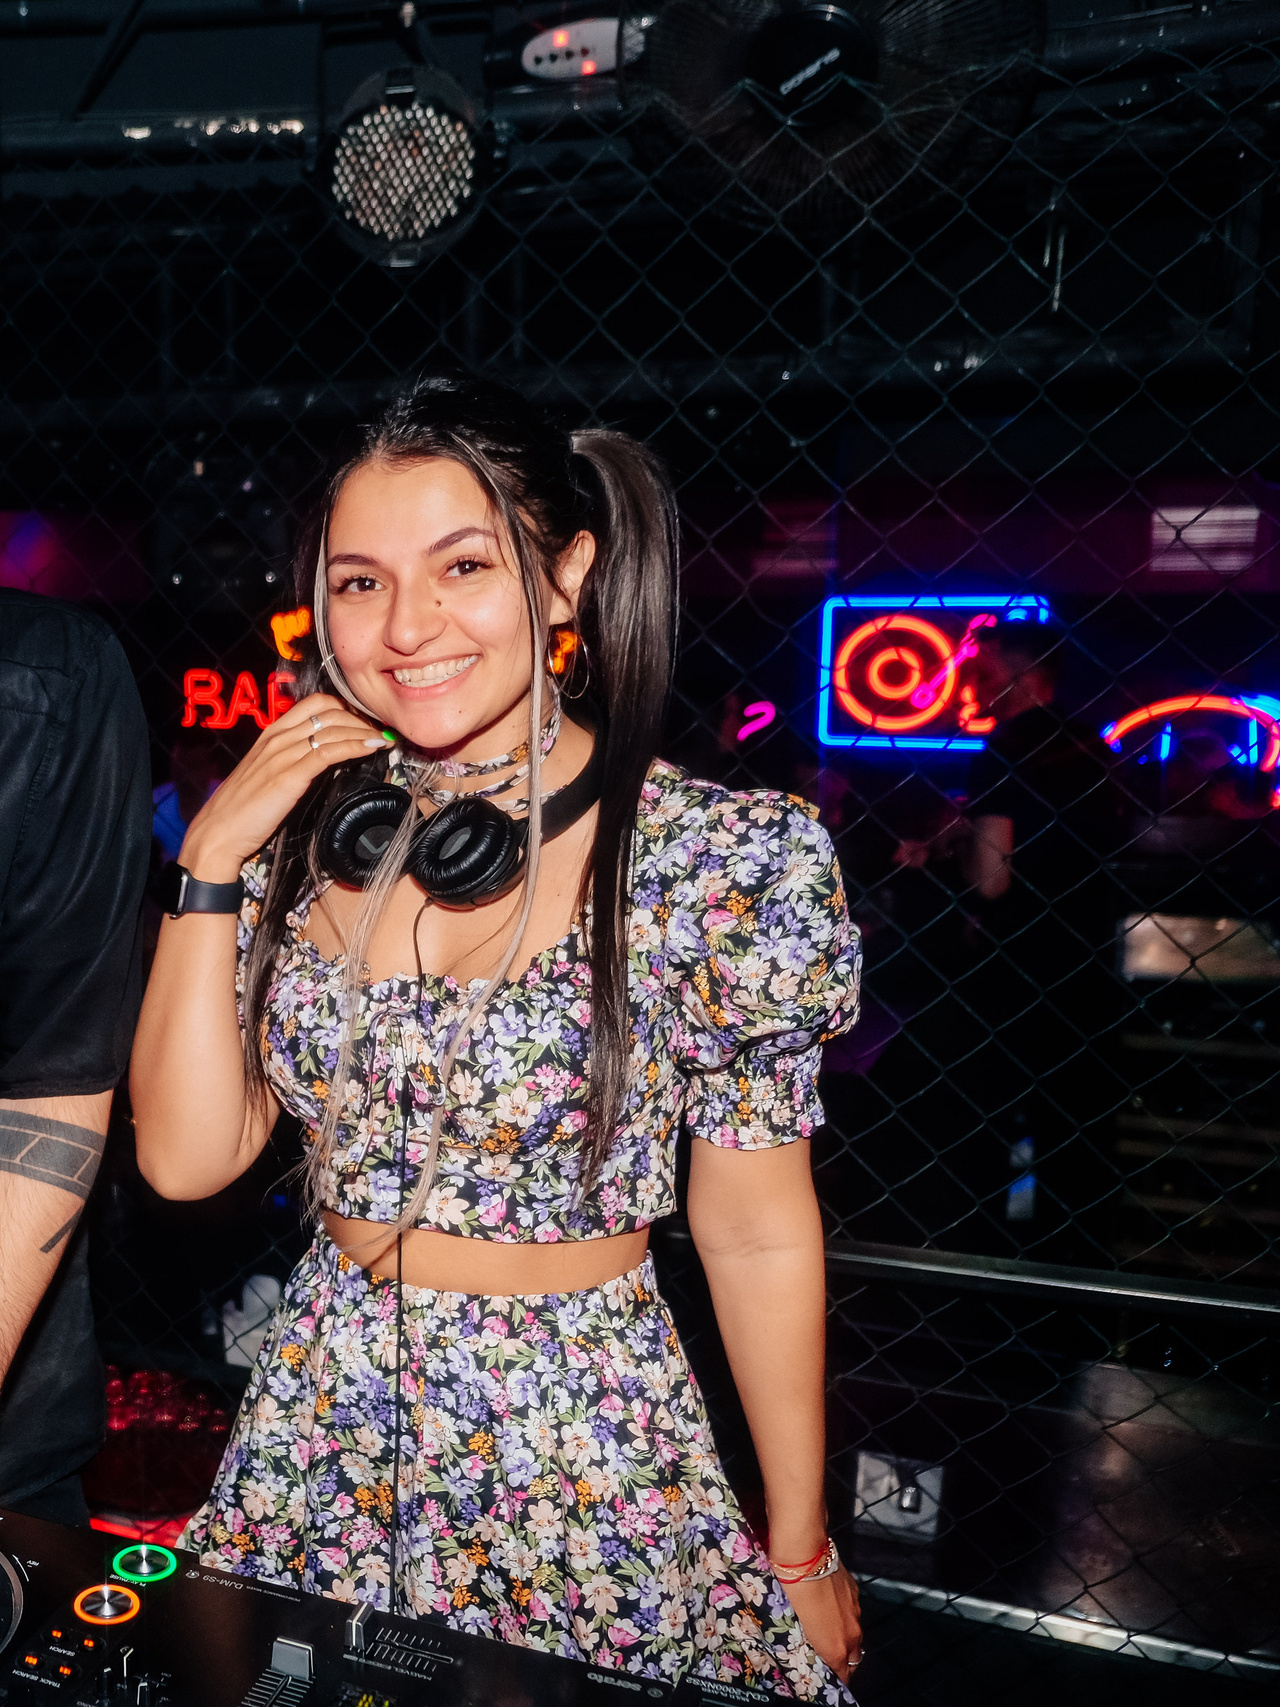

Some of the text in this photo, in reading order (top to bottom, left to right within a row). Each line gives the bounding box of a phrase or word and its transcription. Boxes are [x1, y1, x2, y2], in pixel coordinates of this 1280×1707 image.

[202, 1574, 244, 1590] DJM-S9
[48, 1645, 76, 1657] SEARCH
[12, 1668, 61, 1689] TRACK SEARCH
[586, 1671, 642, 1692] serato
